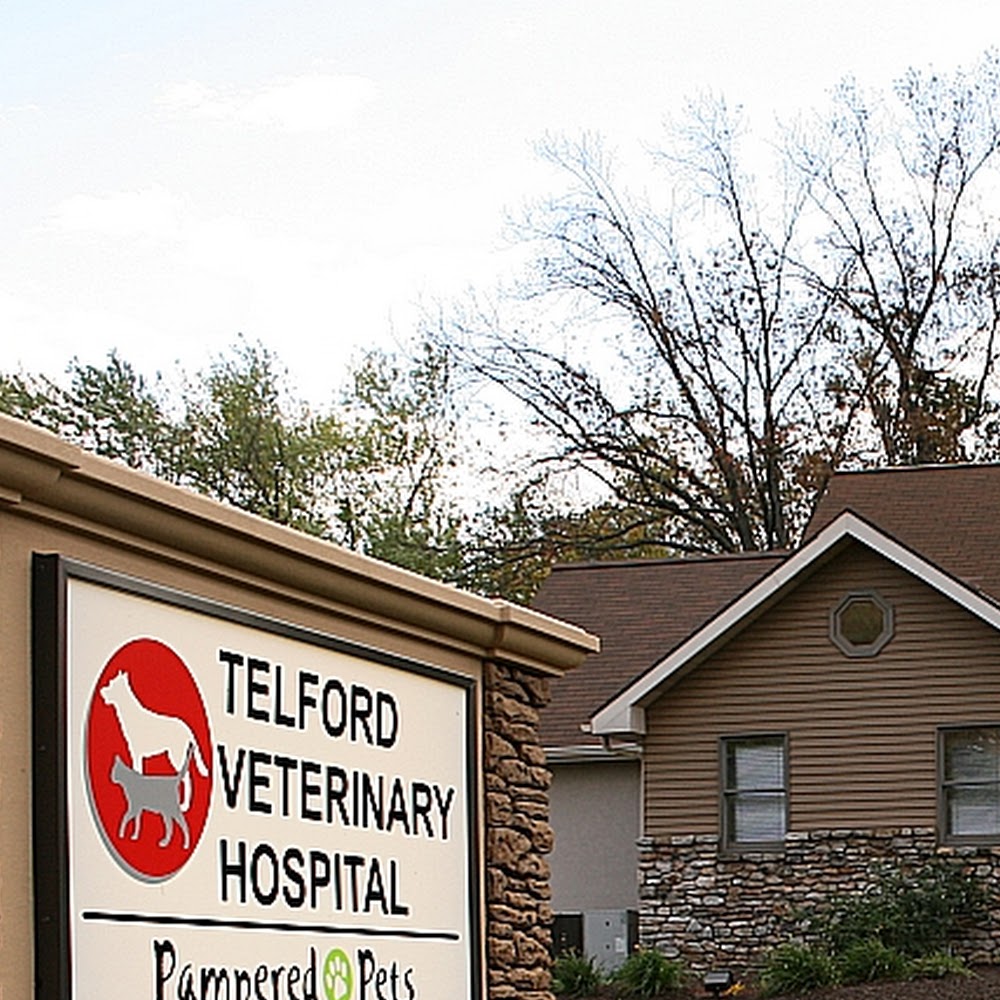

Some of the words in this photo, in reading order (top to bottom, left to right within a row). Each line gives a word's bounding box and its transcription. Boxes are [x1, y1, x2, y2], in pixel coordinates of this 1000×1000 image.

[219, 649, 399, 749] TELFORD
[216, 744, 455, 840] VETERINARY
[219, 838, 410, 916] HOSPITAL
